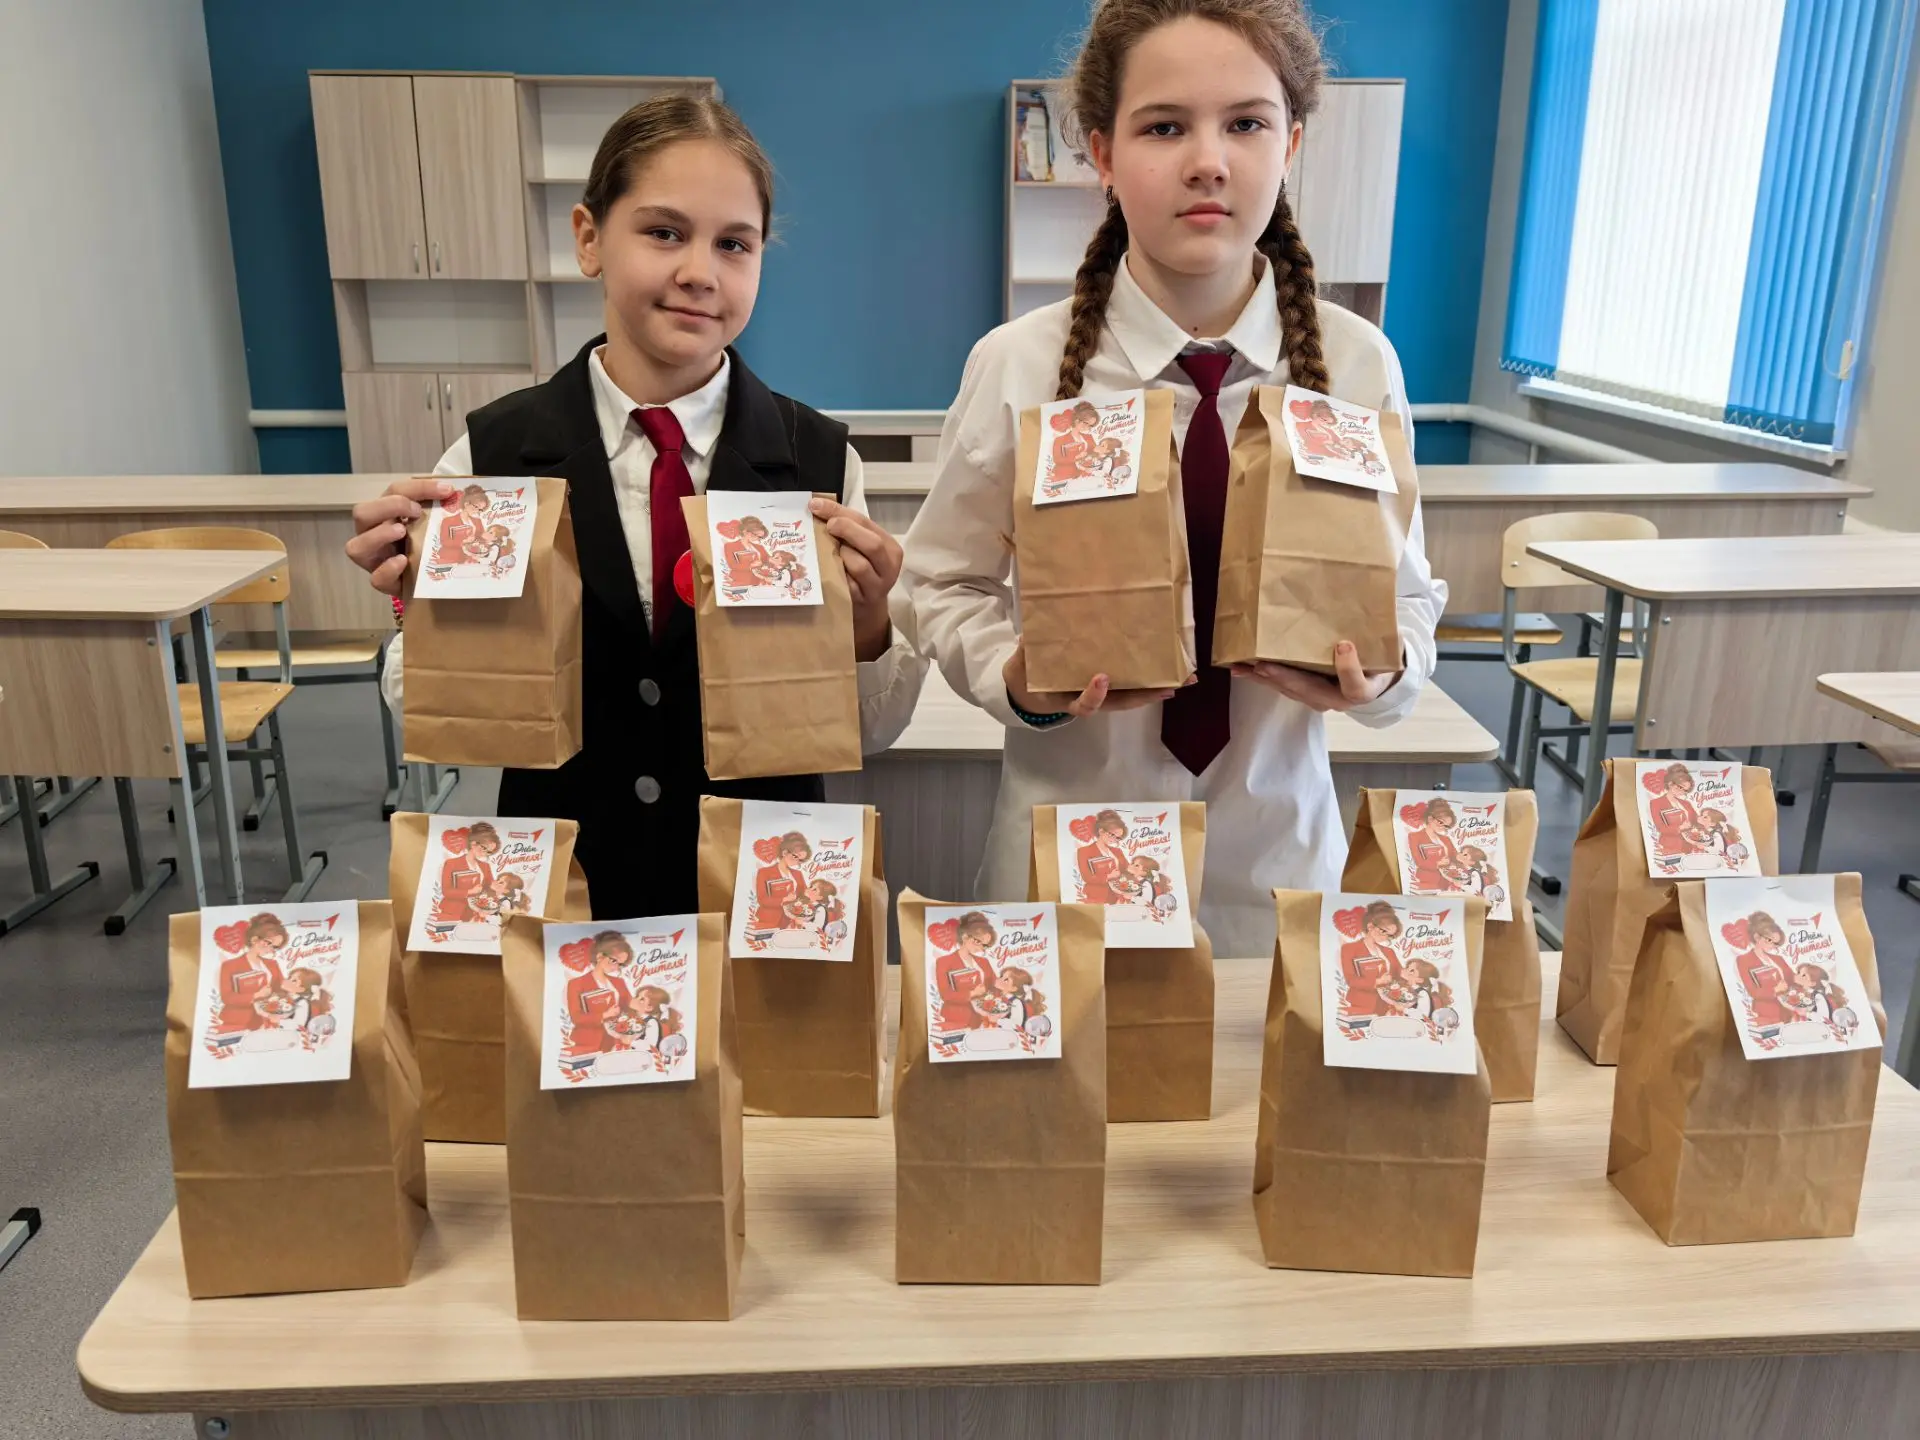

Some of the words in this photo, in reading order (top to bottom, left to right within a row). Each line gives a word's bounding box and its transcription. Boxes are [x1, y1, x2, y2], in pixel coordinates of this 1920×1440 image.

[1697, 783, 1705, 792] С
[1459, 819, 1468, 828] С
[1131, 830, 1140, 839] С
[1127, 832, 1170, 856] Учителя!
[1000, 935, 1010, 946] С
[1010, 931, 1040, 945] Днём
[1406, 926, 1417, 938] С
[1417, 924, 1445, 938] Днём
[1789, 933, 1799, 944] С
[292, 936, 302, 948] С
[1400, 934, 1453, 958] Учителя!
[1786, 935, 1833, 964] Учителя!
[283, 938, 343, 969] Учителя!
[637, 952, 647, 965] С
[648, 949, 680, 964] Днём
[995, 937, 1048, 968] Учителя!
[631, 953, 687, 987] Учителя!
